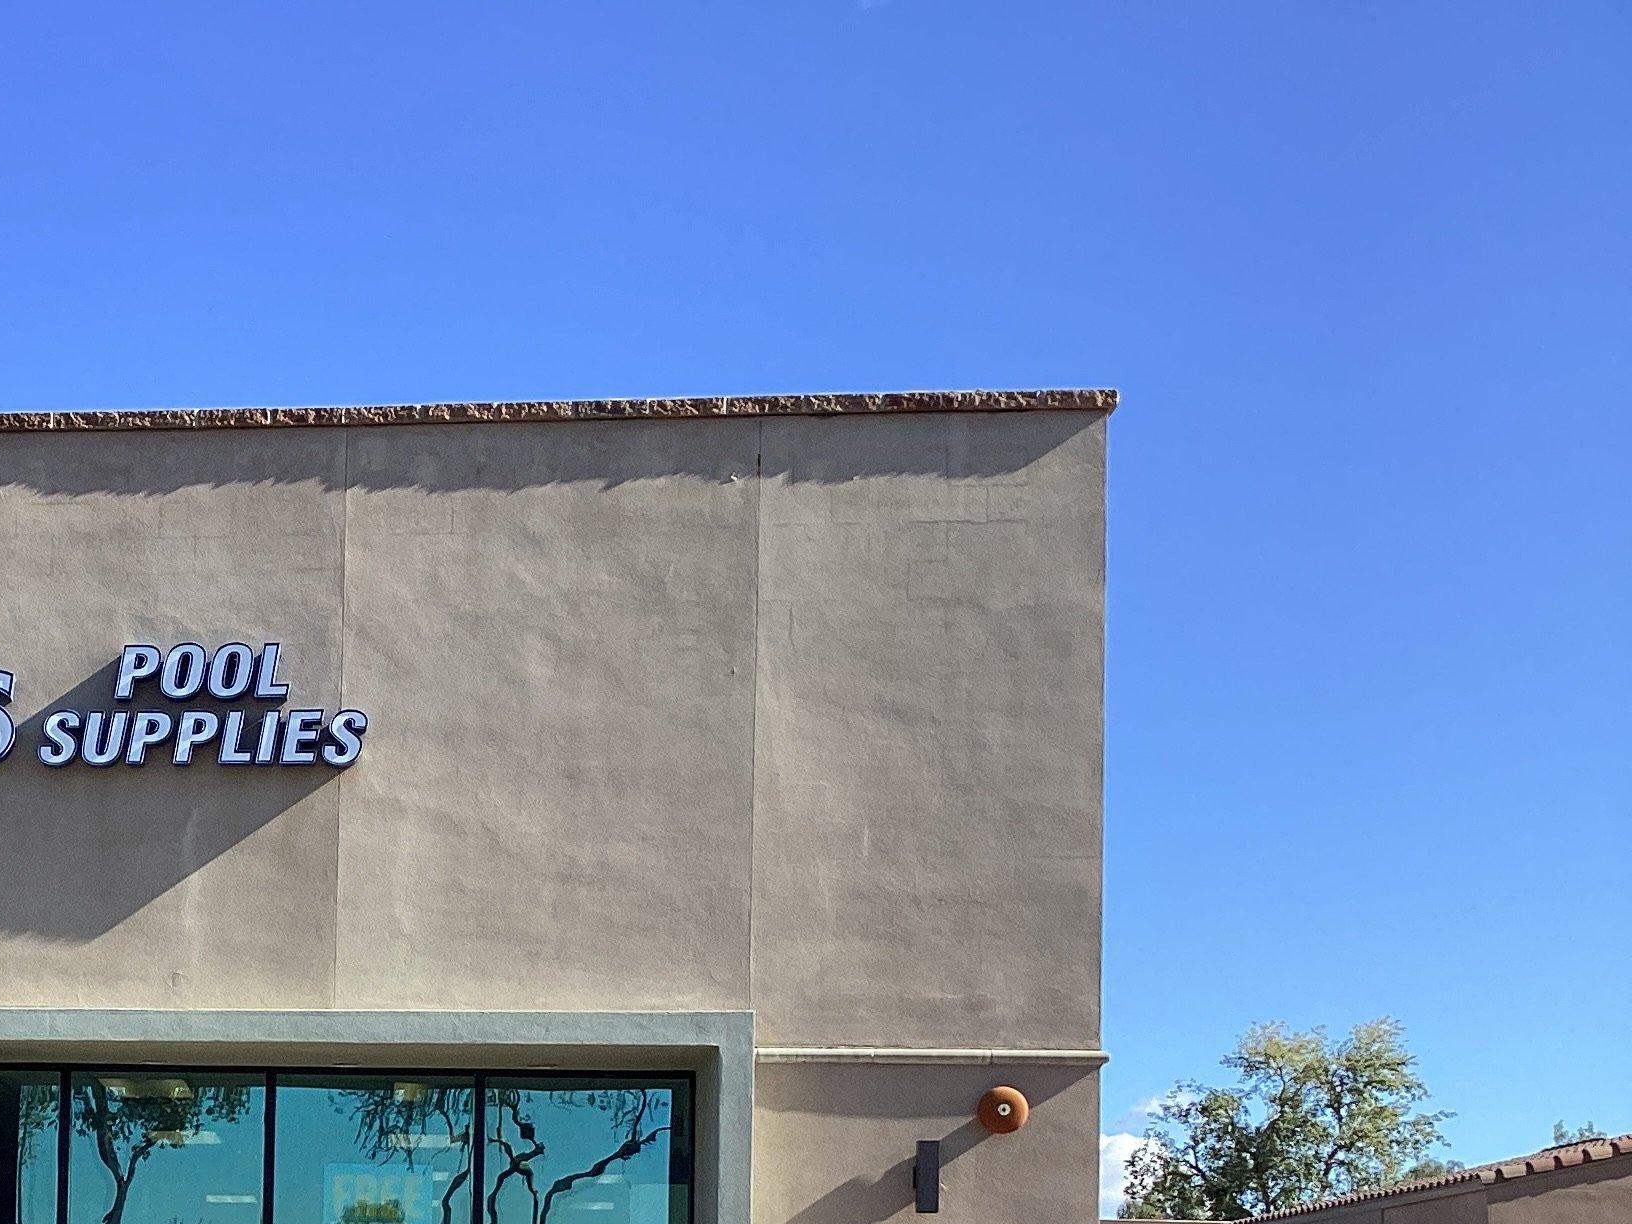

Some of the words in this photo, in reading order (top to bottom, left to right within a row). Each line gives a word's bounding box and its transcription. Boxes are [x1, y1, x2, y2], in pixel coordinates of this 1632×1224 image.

[113, 642, 291, 701] POOL
[36, 708, 369, 768] SUPPLIES
[332, 1174, 424, 1219] FREE
